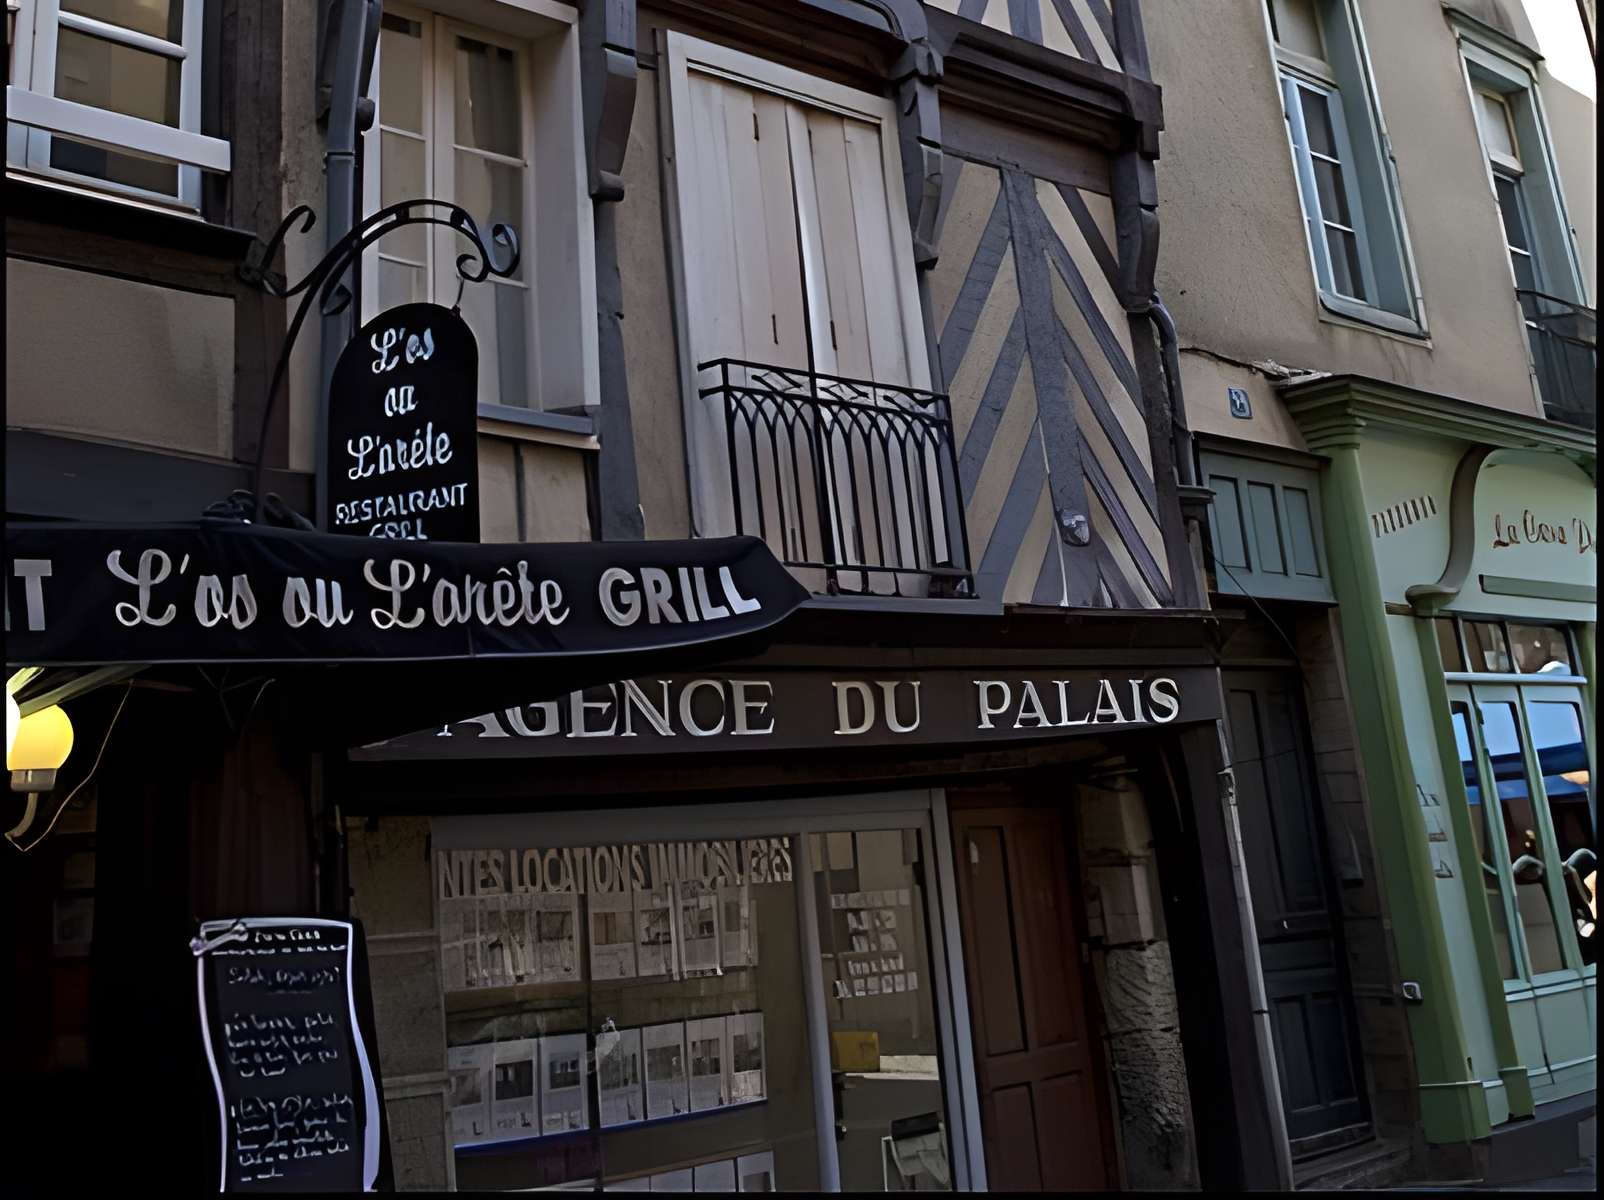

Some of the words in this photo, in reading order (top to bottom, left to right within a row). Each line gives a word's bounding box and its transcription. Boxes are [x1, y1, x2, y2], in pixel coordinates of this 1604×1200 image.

[335, 482, 468, 525] RESTAURANT
[106, 549, 258, 630] L'os
[282, 576, 354, 628] ou
[363, 559, 570, 629] L'arête
[599, 565, 762, 626] GRILL
[831, 680, 921, 735] DU
[972, 677, 1180, 729] PALAIS
[511, 842, 645, 893] LOCATIONS
